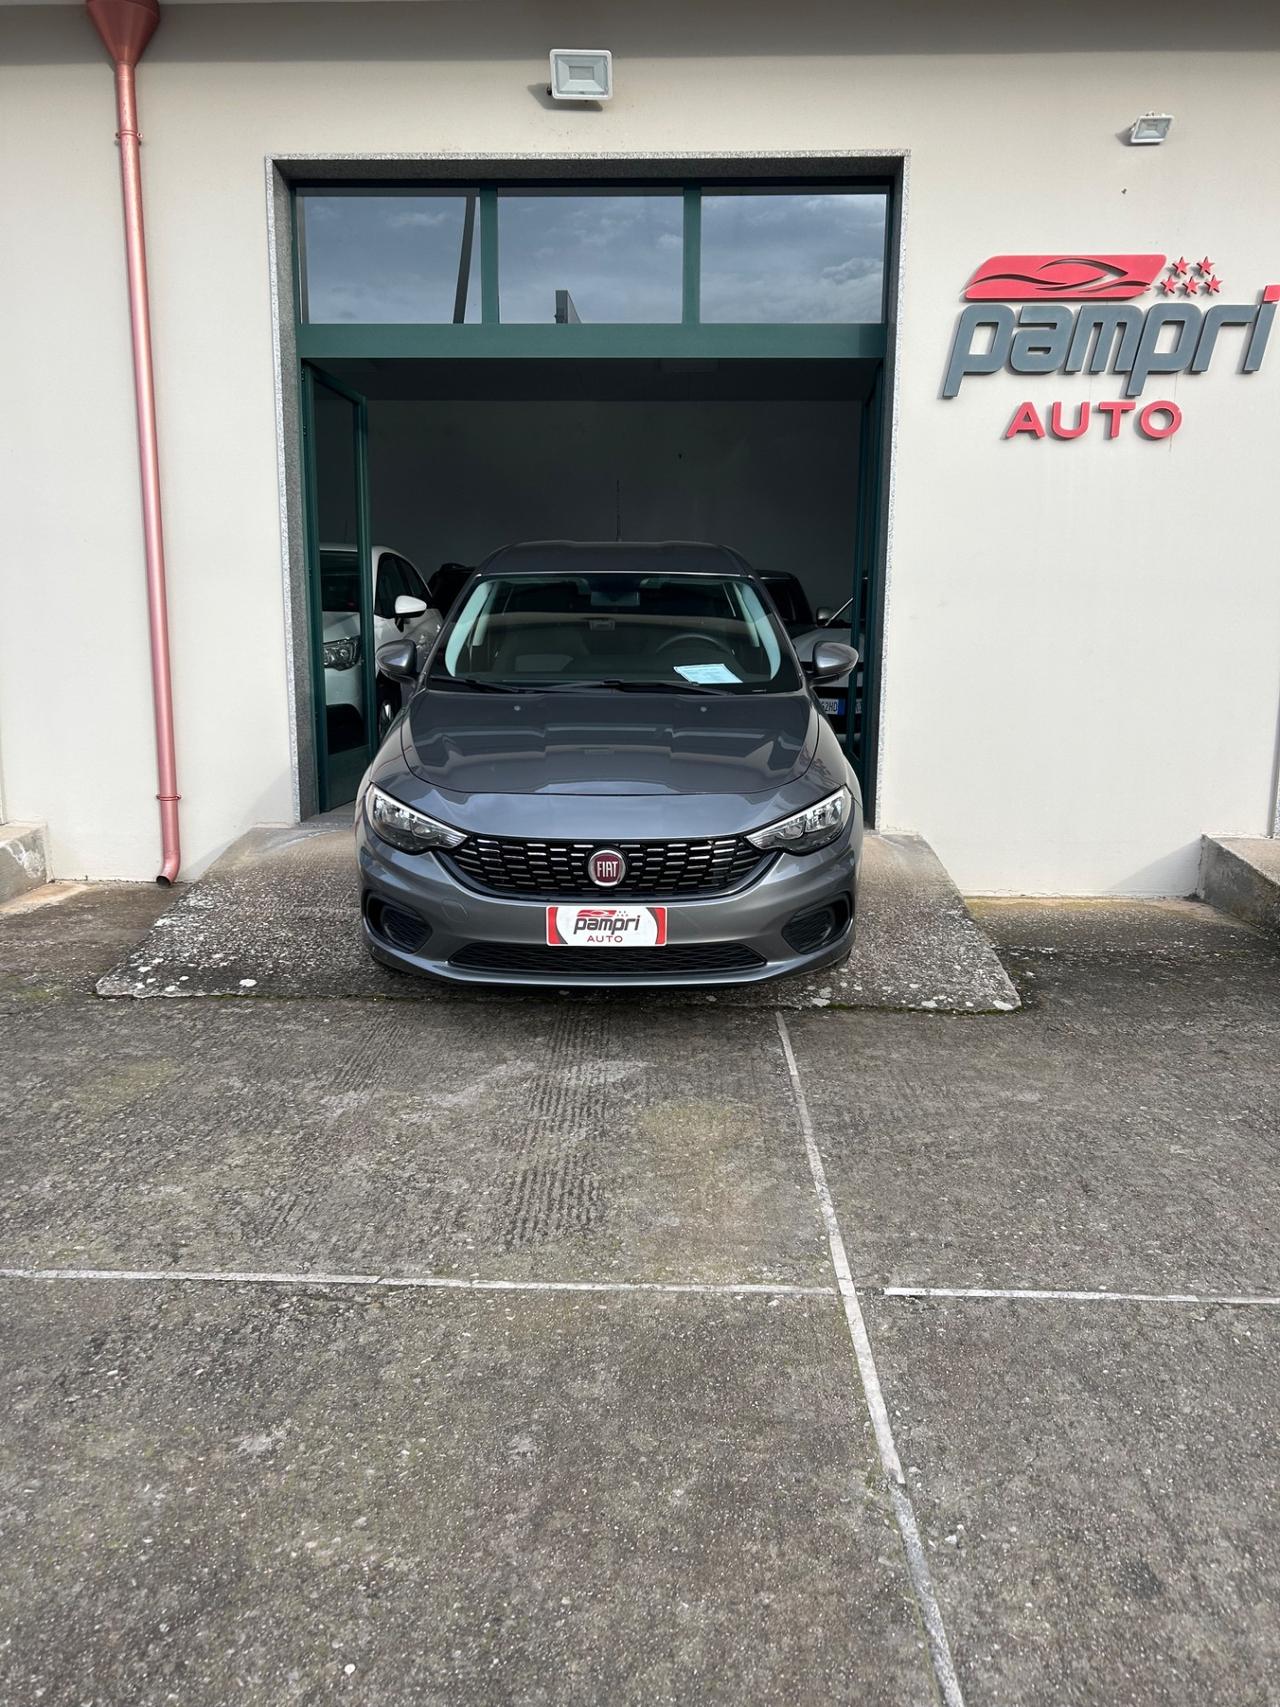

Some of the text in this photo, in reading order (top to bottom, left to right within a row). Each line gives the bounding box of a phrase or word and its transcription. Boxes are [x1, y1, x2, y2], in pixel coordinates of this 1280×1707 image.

[942, 285, 1280, 398] pampri
[1004, 400, 1183, 439] AUTO
[596, 861, 618, 878] FIAT
[573, 915, 641, 935] pampri
[586, 935, 623, 943] AUTO
